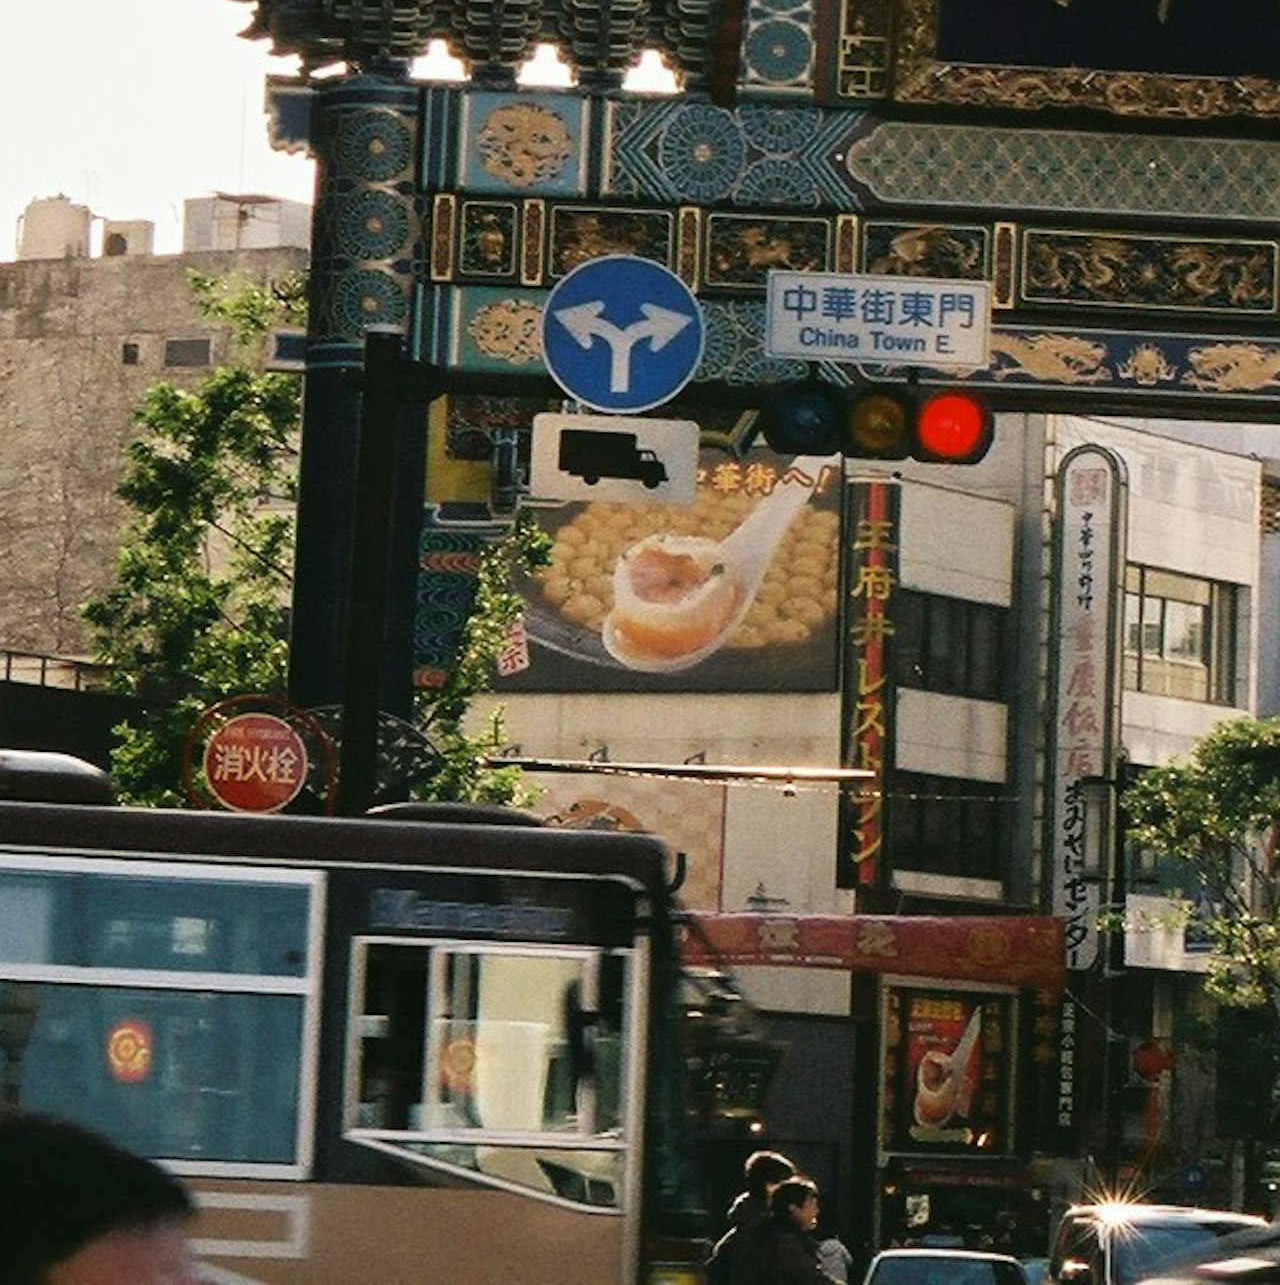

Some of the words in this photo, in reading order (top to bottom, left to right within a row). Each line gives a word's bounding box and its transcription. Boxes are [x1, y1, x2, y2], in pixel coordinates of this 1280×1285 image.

[783, 274, 975, 329] 中華街東門
[798, 326, 859, 349] China
[870, 330, 926, 352] Town
[934, 334, 955, 354] E.
[696, 460, 832, 495] 華街へ!
[213, 743, 299, 783] 消火栓
